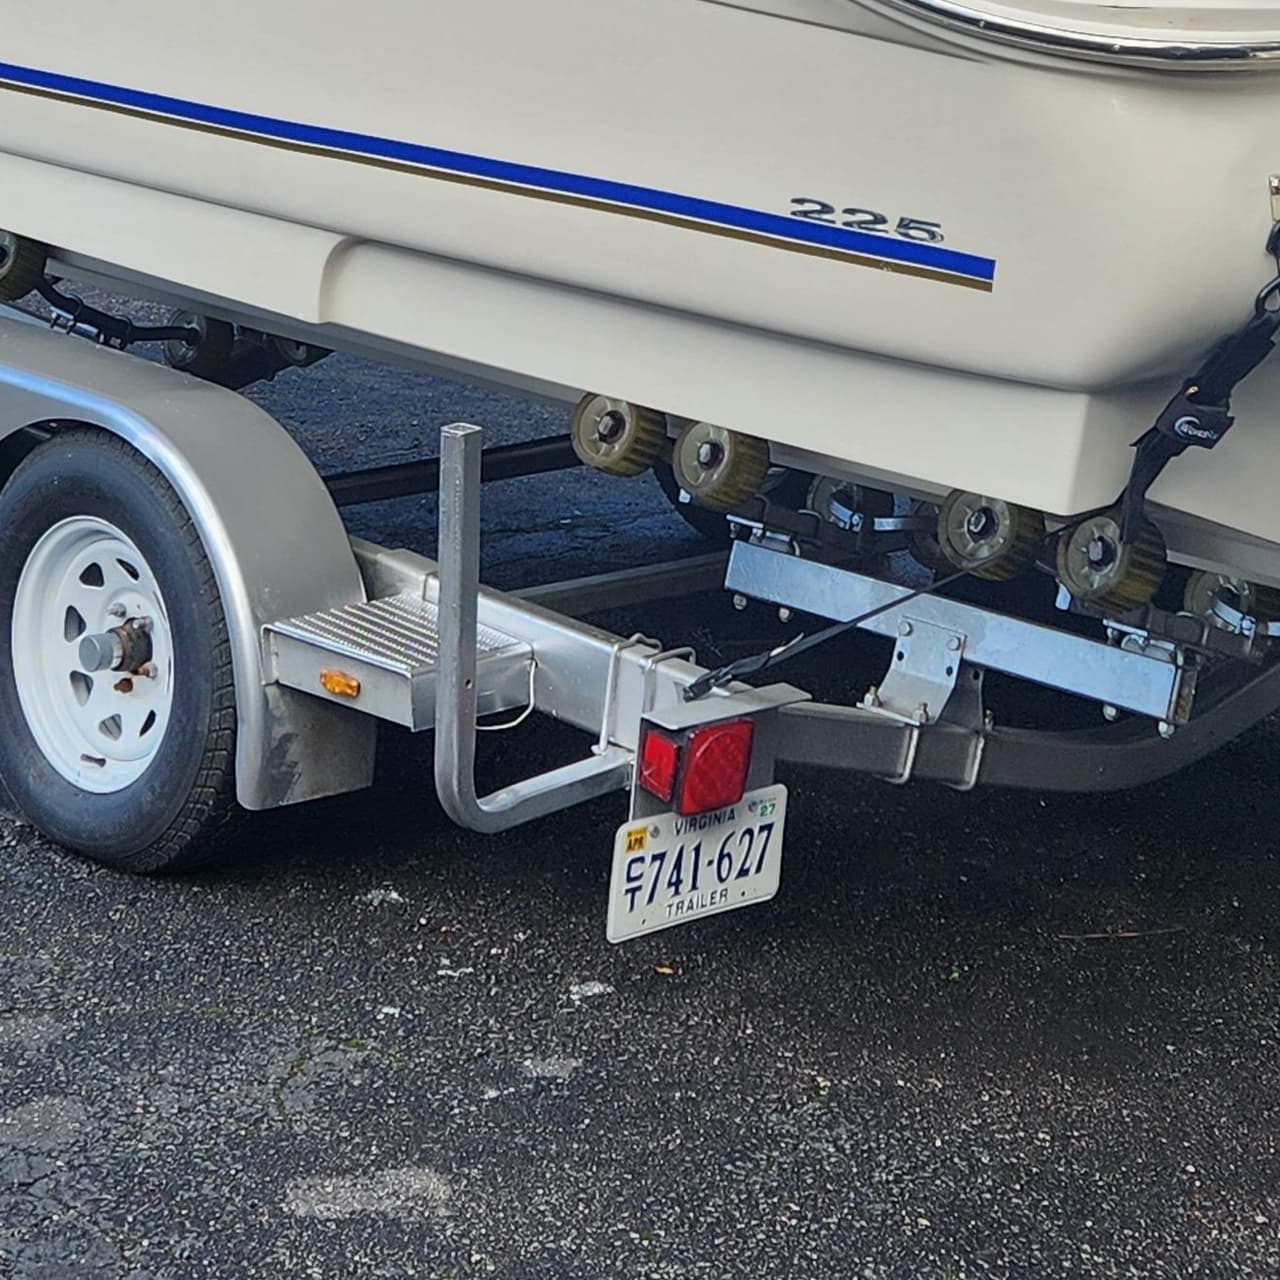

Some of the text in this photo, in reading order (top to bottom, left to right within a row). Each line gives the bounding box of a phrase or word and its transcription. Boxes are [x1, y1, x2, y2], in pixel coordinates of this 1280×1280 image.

[790, 198, 944, 243] 225
[674, 808, 735, 836] VIRGINIA
[760, 803, 775, 816] 27
[646, 822, 775, 906] 741-627
[666, 888, 729, 919] TRAILER
